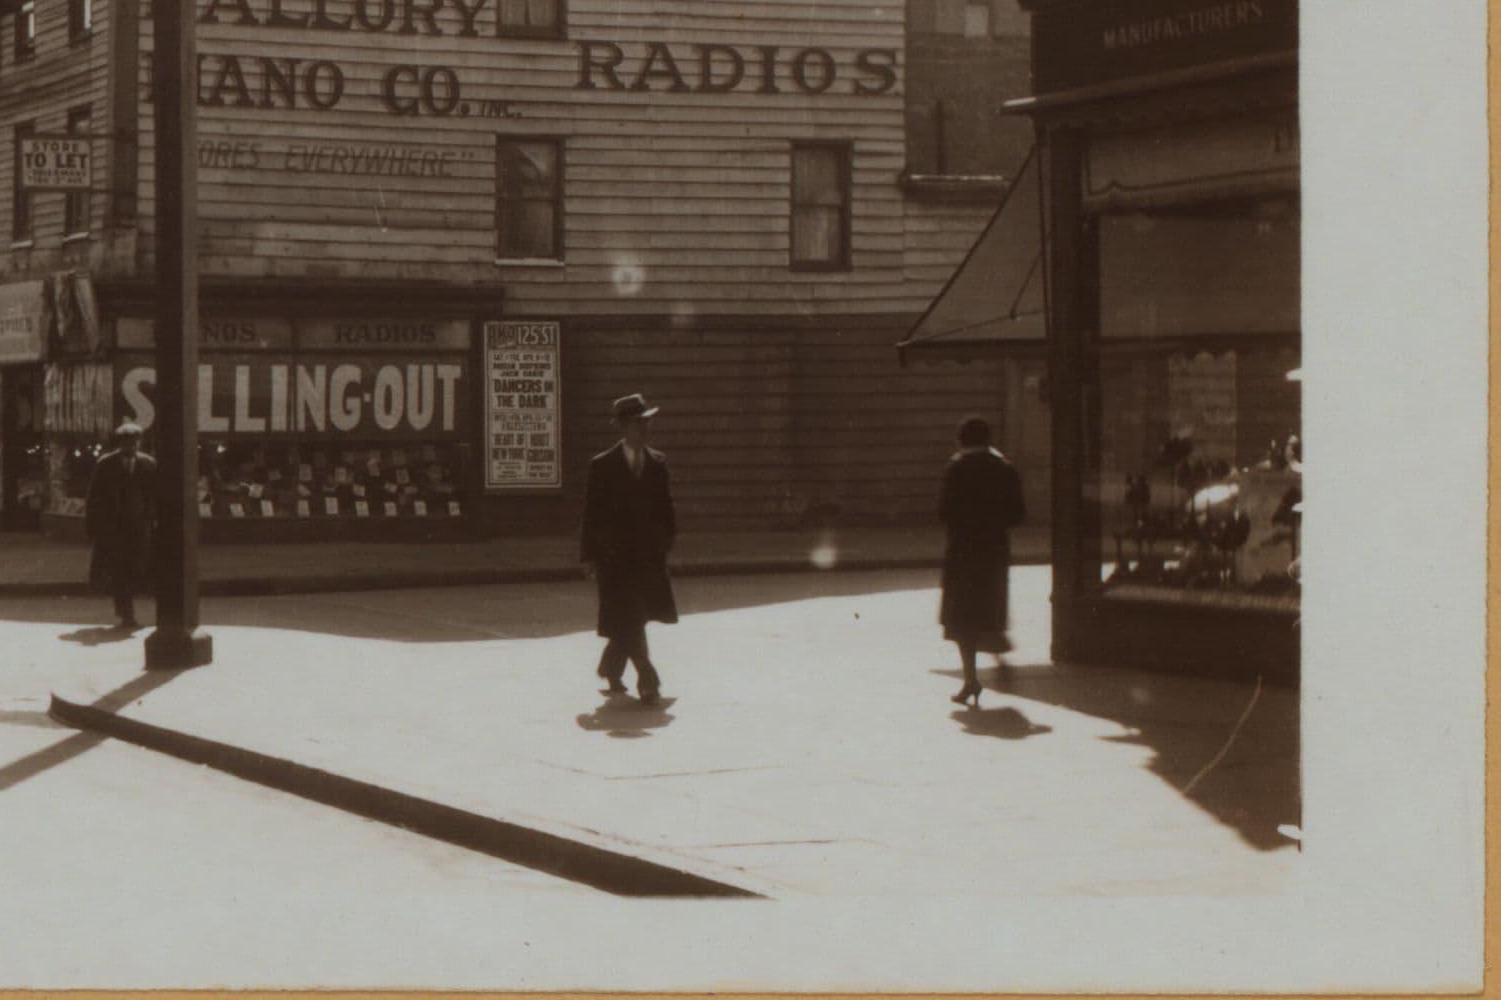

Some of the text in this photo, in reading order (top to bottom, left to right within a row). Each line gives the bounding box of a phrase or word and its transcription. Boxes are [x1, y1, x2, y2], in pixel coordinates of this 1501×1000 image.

[1102, 0, 1263, 49] MANUFACTURERS
[575, 40, 900, 97] RADIOS
[143, 53, 523, 121] IANO CO. INC.
[32, 141, 79, 153] STORE
[196, 141, 262, 170] ORES
[25, 153, 88, 168] TO LET
[336, 323, 437, 344] RADIOS
[494, 379, 542, 393] DANCERS
[496, 395, 548, 409] THE DARK
